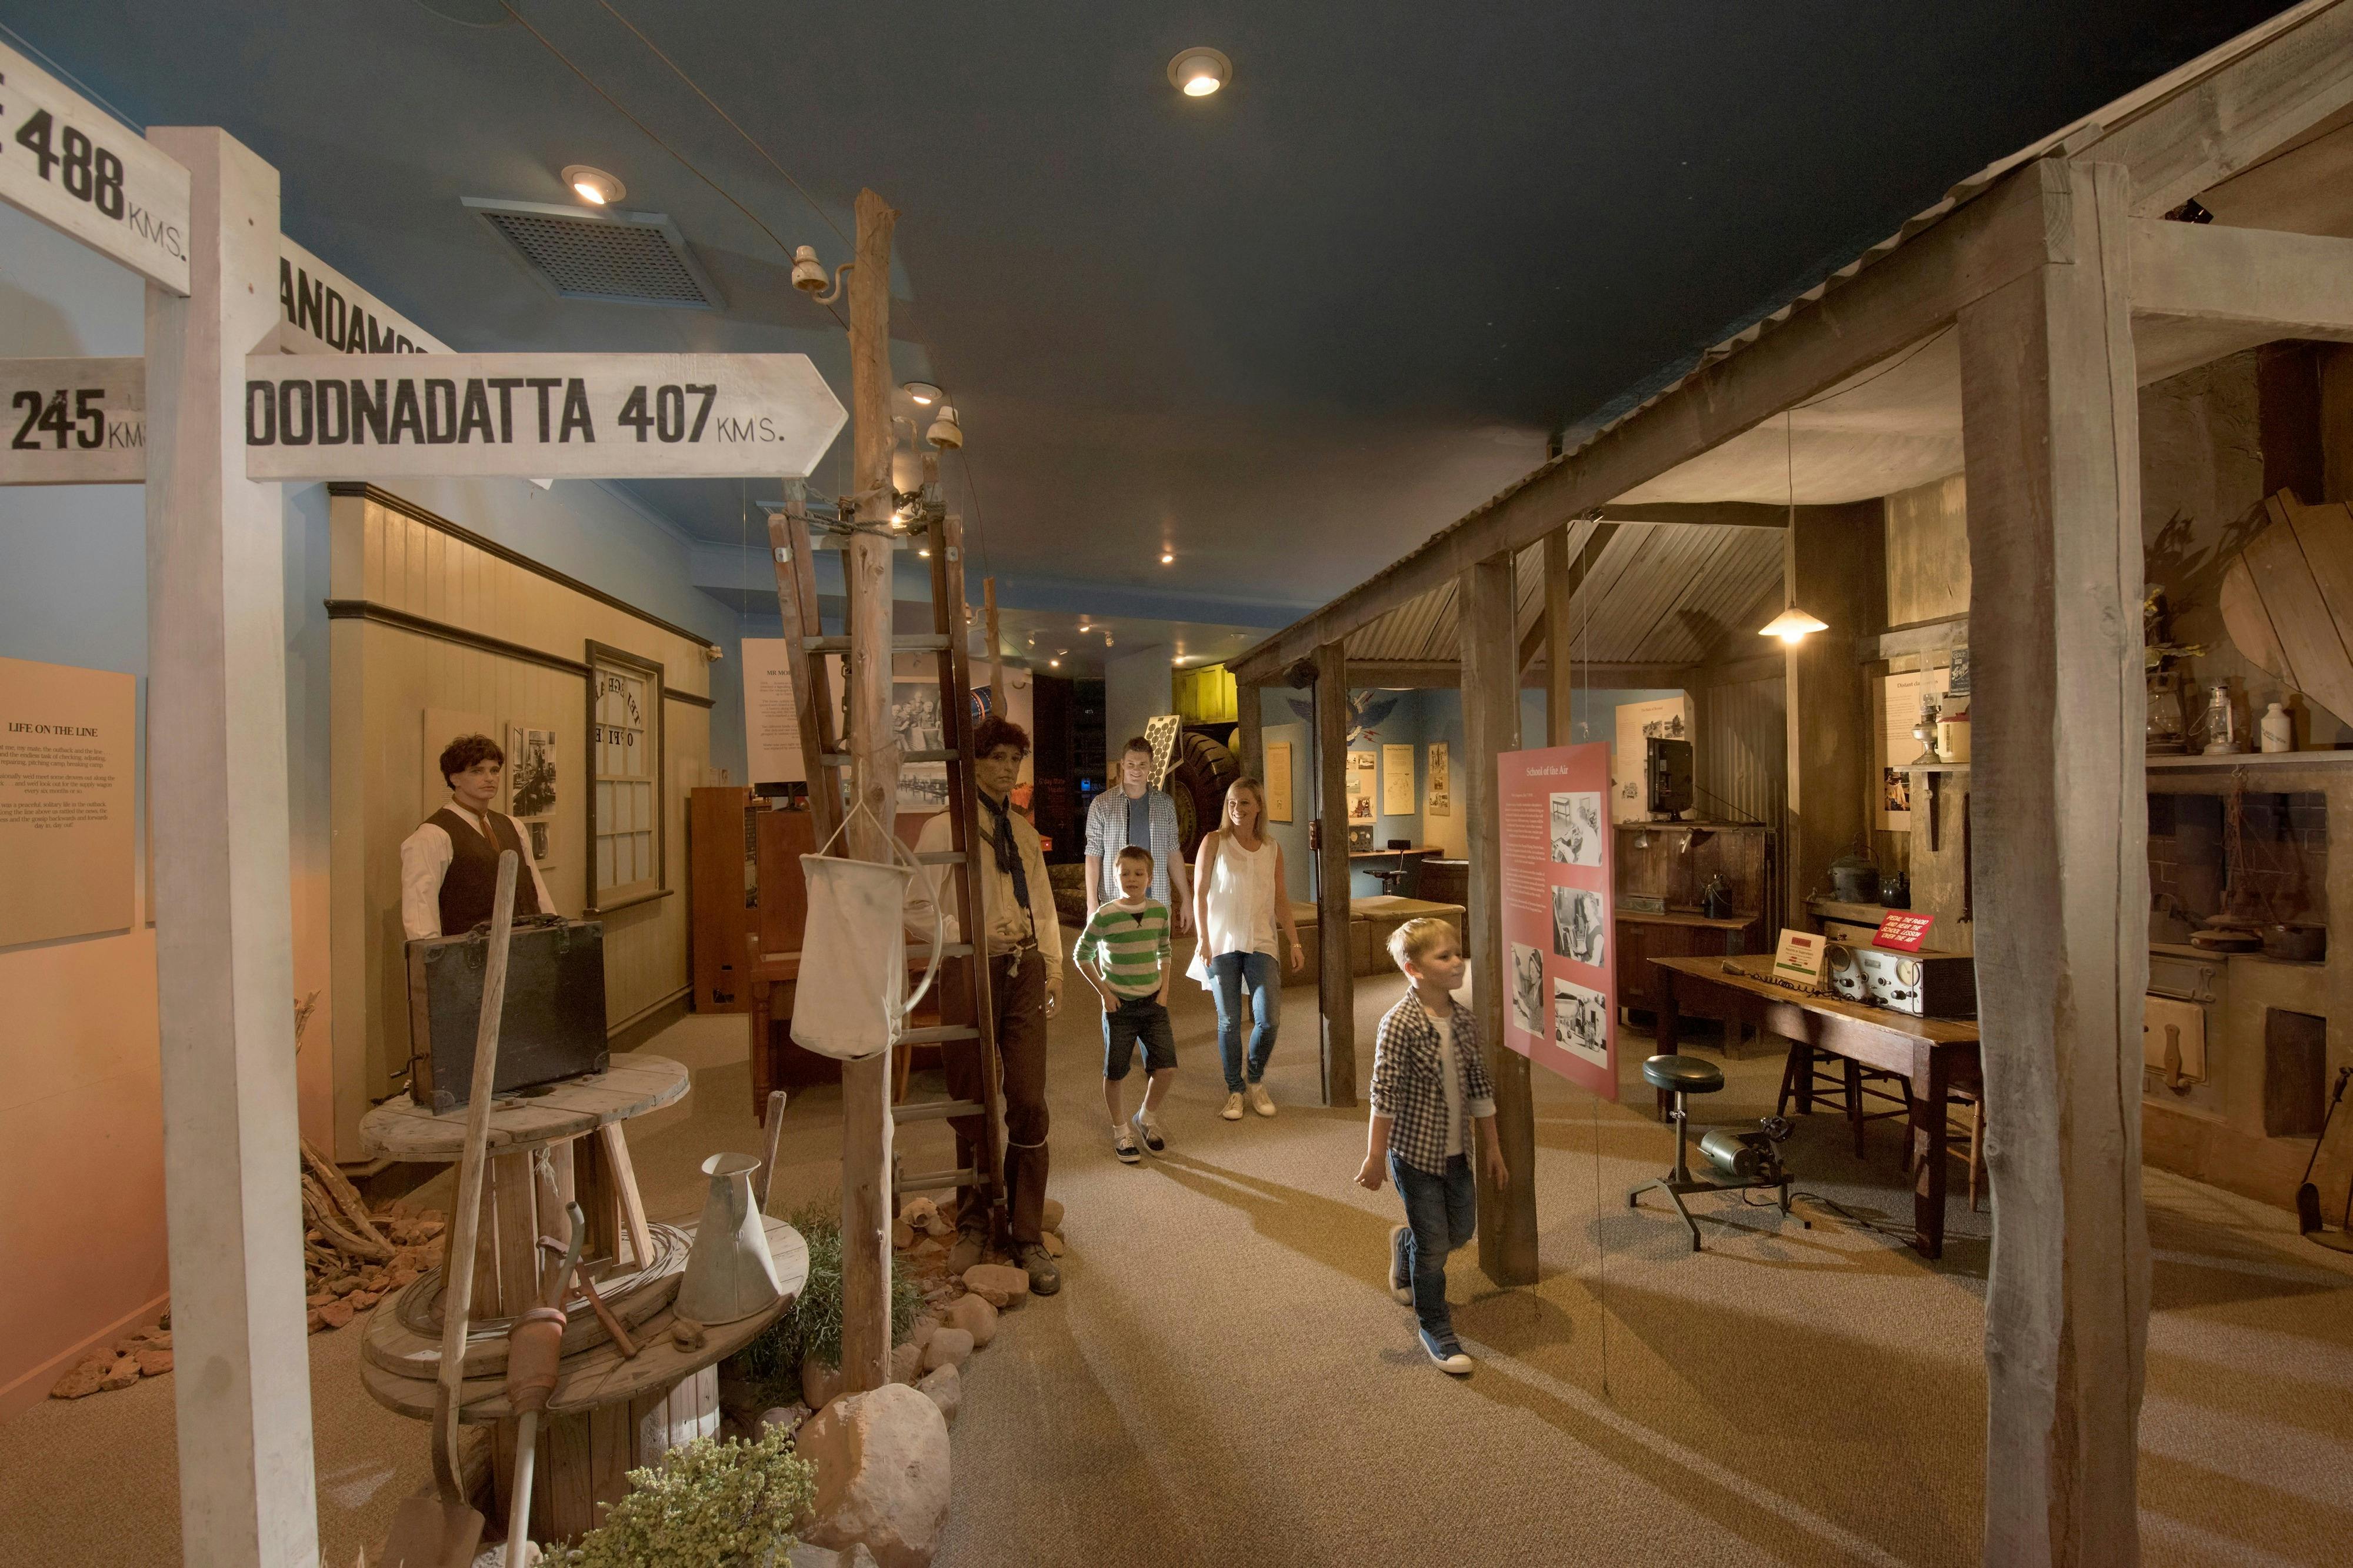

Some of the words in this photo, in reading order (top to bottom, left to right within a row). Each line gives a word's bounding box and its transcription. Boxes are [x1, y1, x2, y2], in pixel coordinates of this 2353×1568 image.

[15, 108, 124, 221] 488
[129, 201, 186, 262] KMS.
[12, 389, 105, 449] 245
[109, 422, 146, 449] KM
[246, 378, 595, 446] OODNADATTA
[618, 383, 717, 443] 407
[718, 418, 785, 442] KMS.
[9, 722, 33, 733] LIFE
[35, 725, 51, 734] ON
[53, 726, 74, 735] THE
[76, 728, 98, 737] LINE
[1526, 767, 1542, 776] School
[1544, 766, 1549, 775] of
[1550, 766, 1558, 775] the
[1559, 765, 1569, 775] Air
